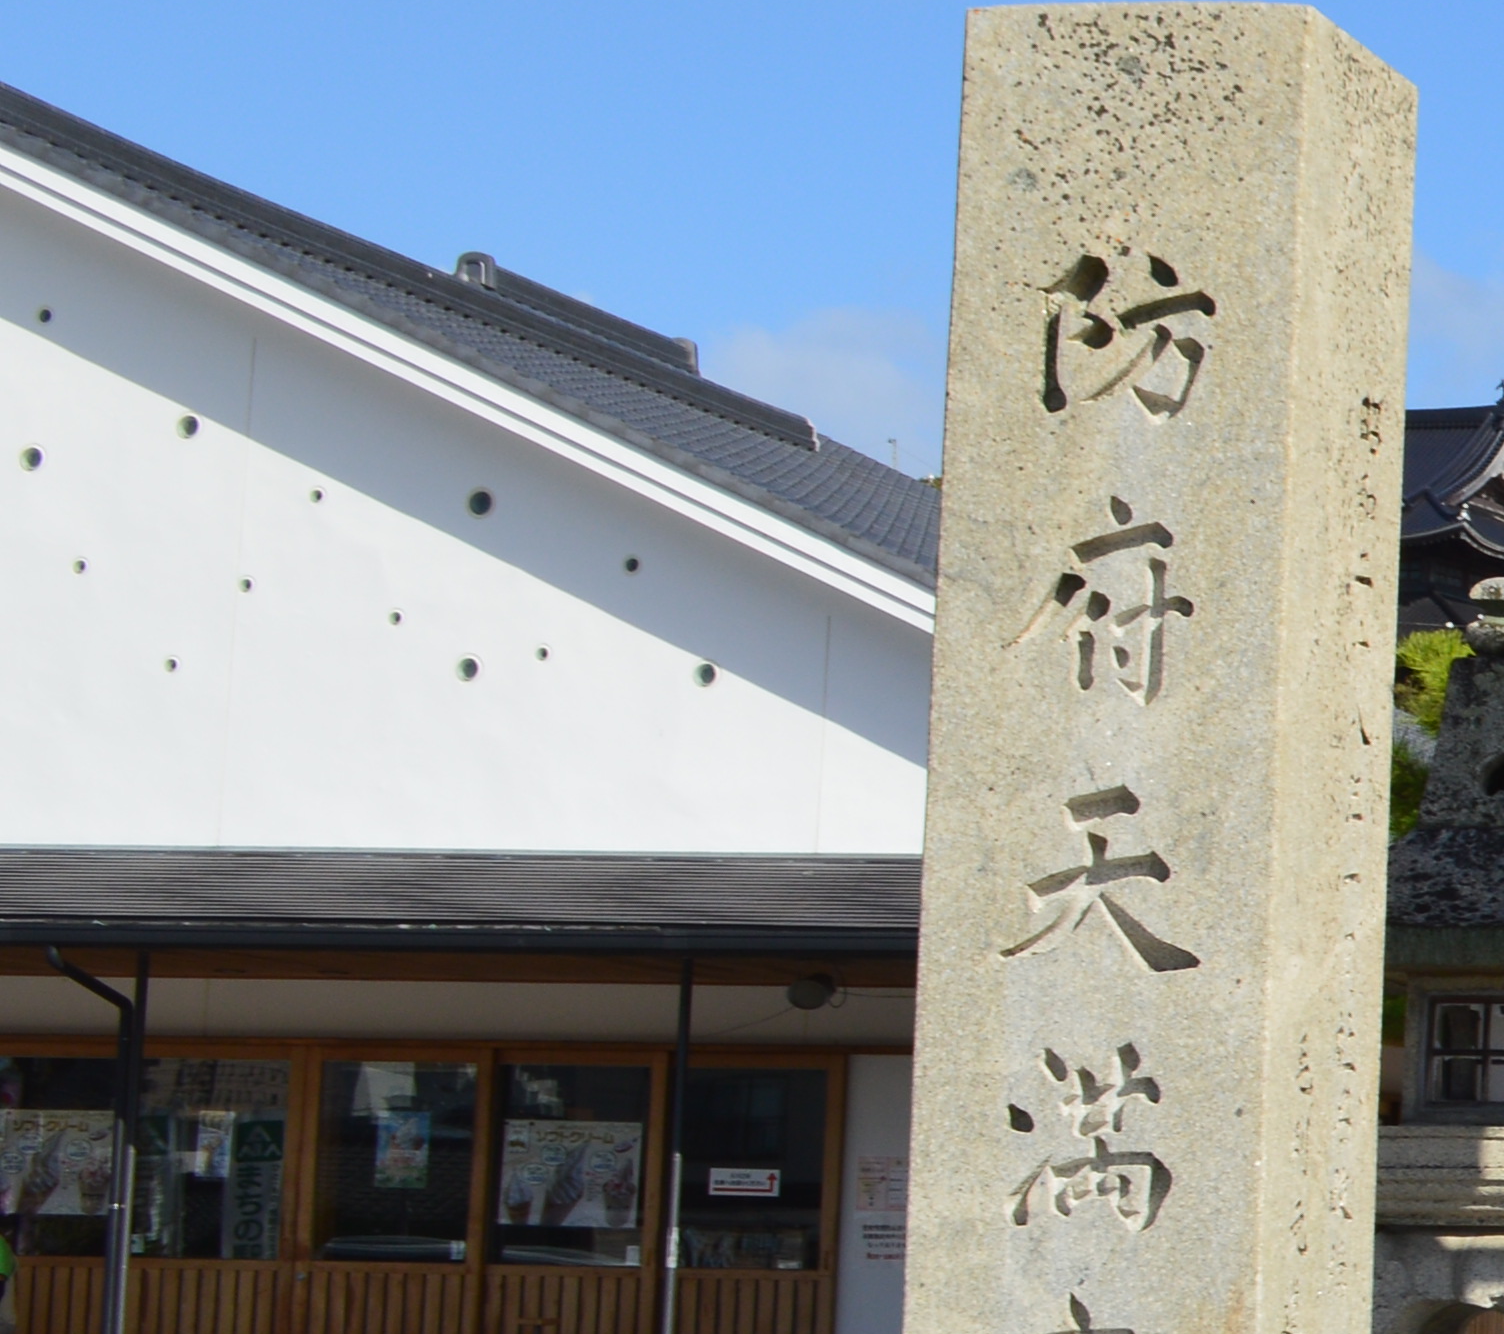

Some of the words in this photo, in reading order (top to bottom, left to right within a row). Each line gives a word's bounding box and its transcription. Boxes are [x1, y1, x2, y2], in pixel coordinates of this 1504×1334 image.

[535, 1130, 616, 1144] ソフトクリーム
